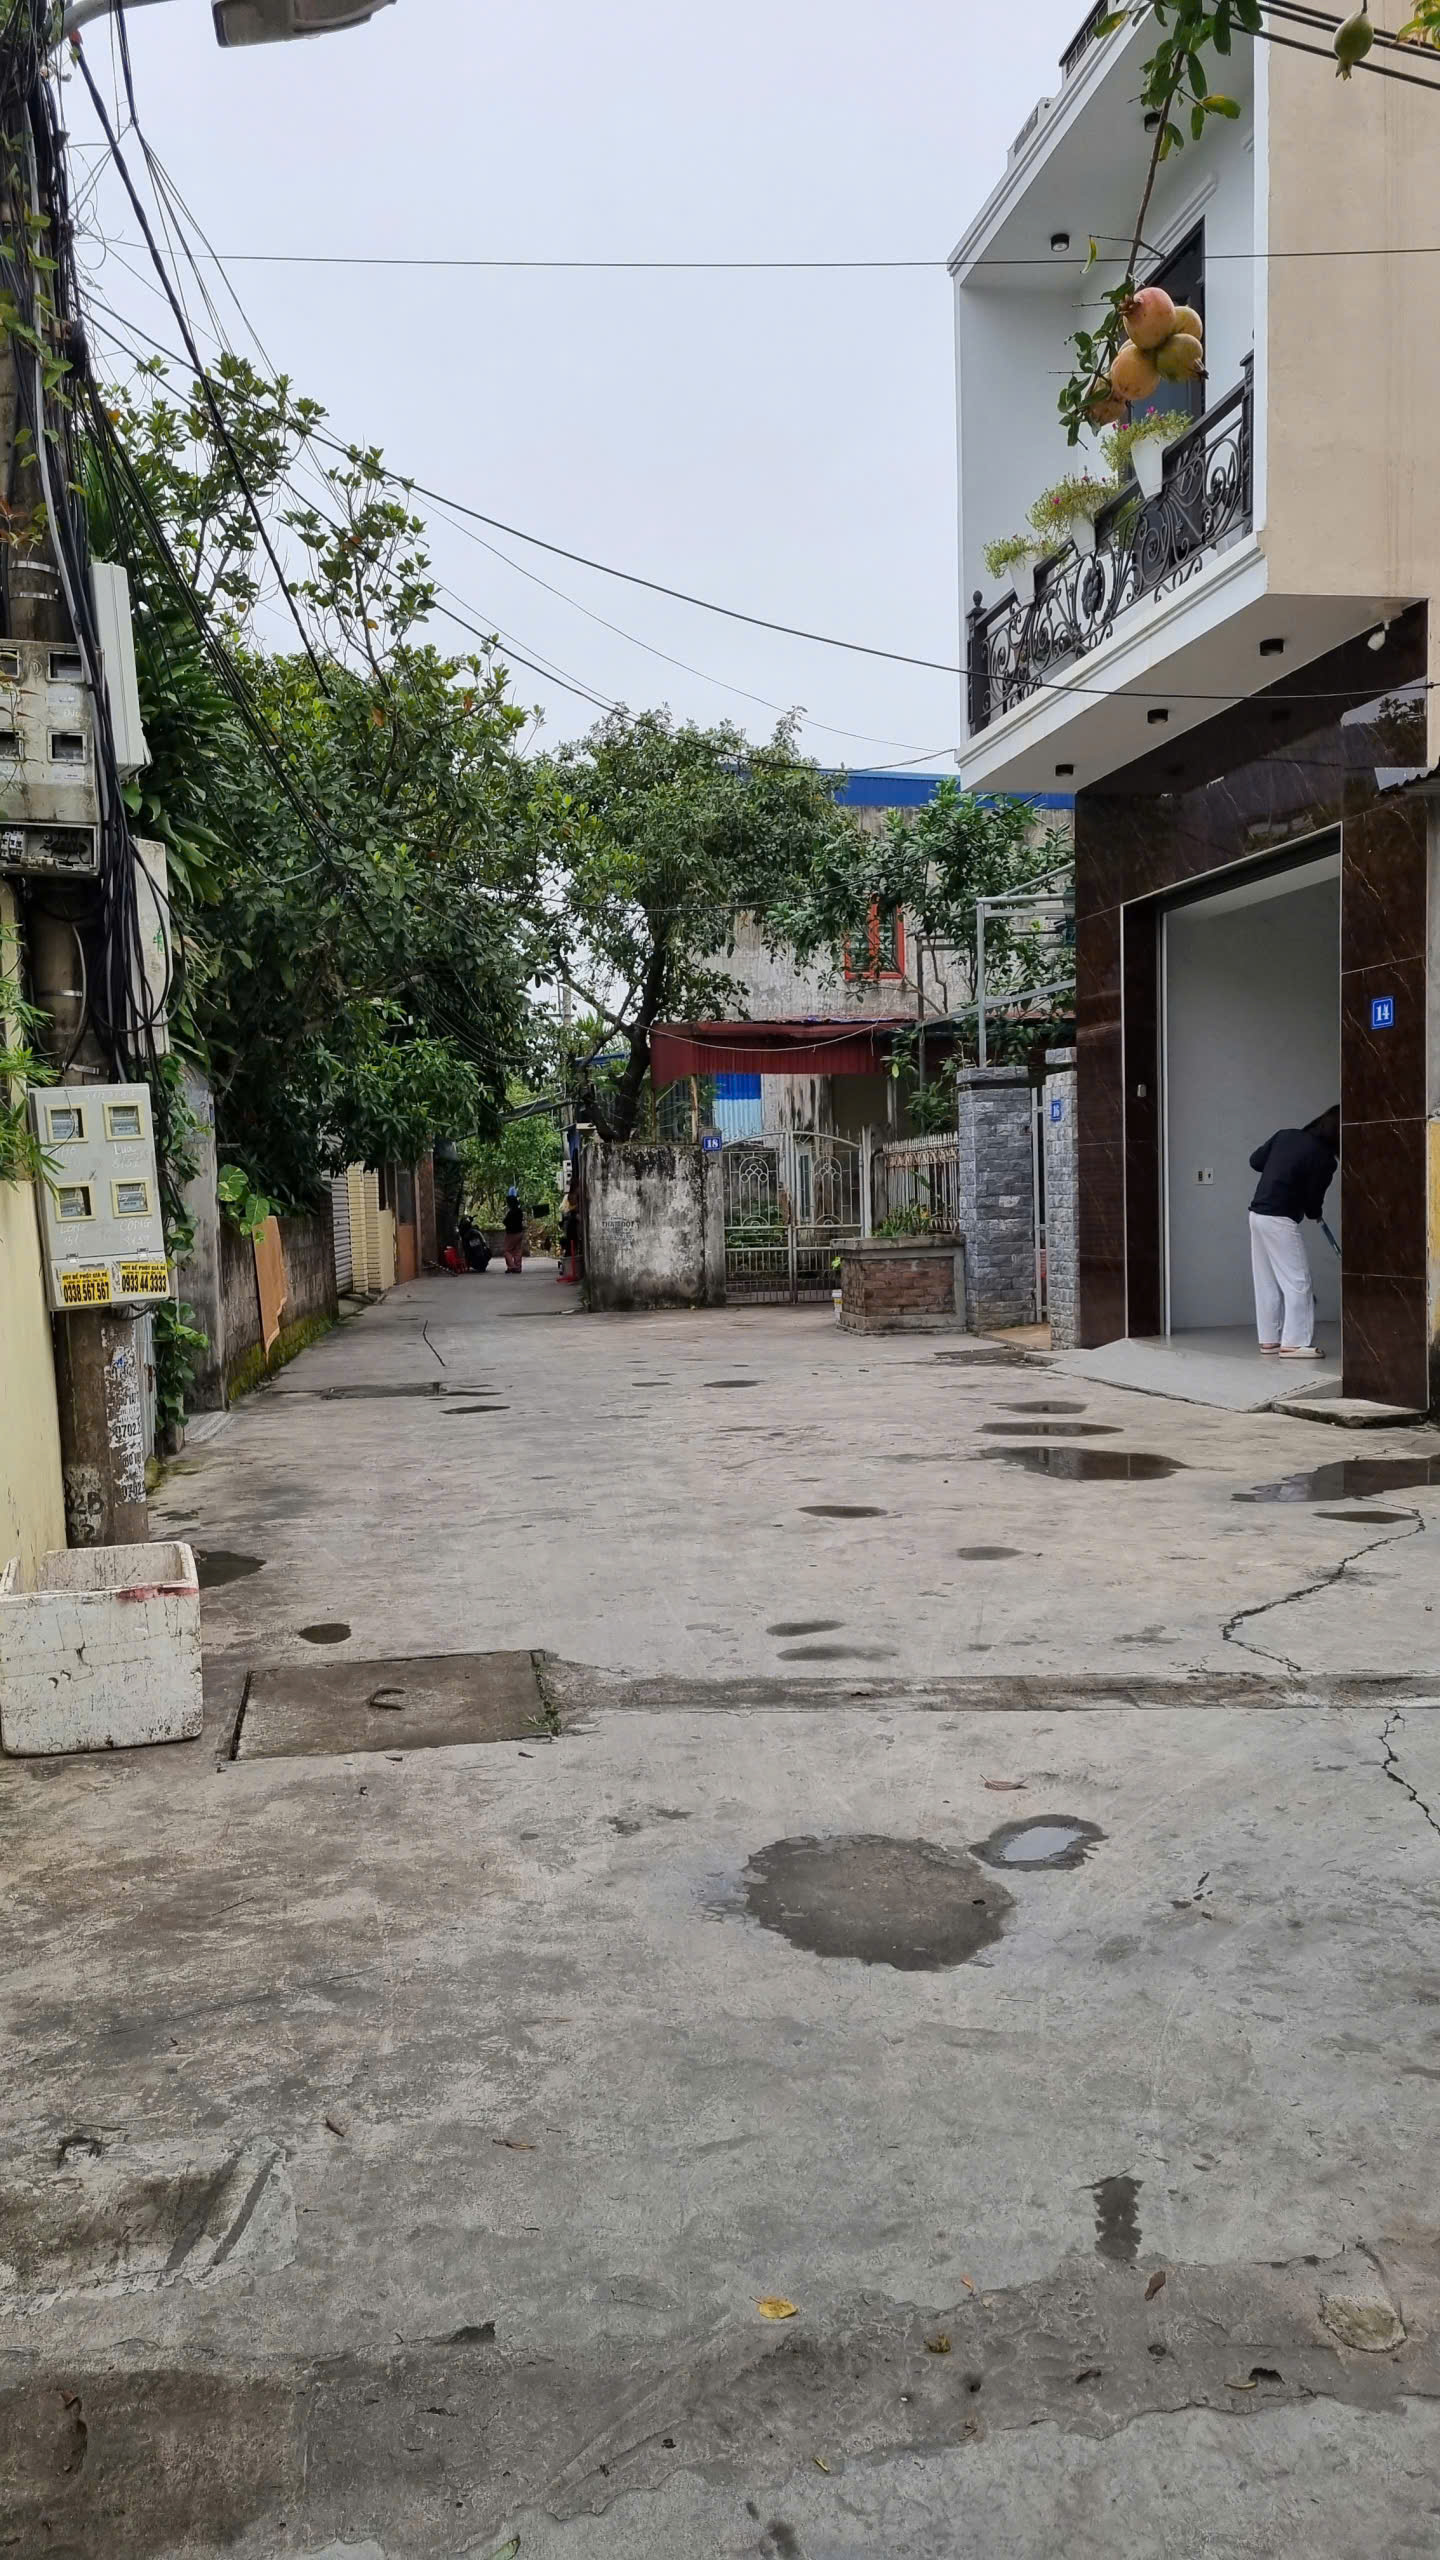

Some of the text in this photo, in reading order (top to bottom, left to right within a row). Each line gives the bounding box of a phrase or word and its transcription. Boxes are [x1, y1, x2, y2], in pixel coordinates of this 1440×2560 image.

[1376, 1003, 1390, 1022] 14
[707, 1139, 719, 1148] 18
[63, 1281, 110, 1303] 0338.567.567
